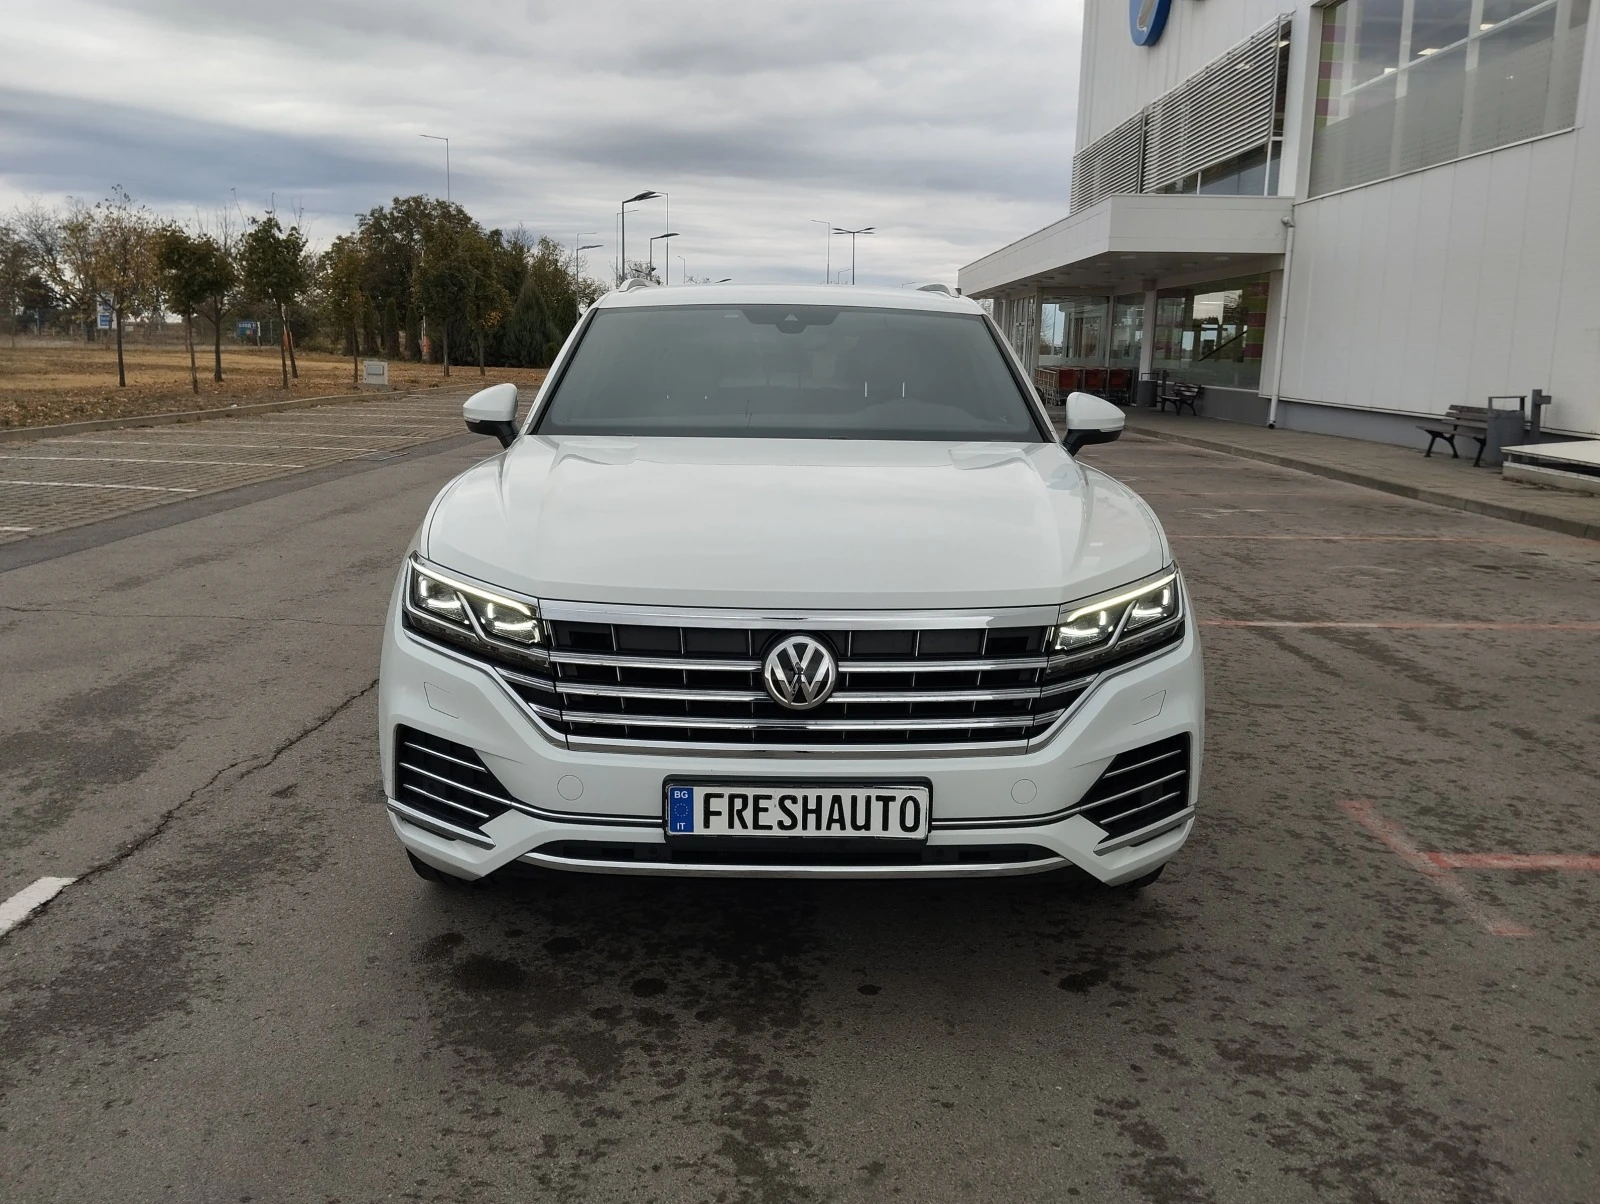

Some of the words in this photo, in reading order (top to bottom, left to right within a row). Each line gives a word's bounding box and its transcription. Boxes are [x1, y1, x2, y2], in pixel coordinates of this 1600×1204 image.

[765, 636, 835, 710] VW
[674, 790, 689, 799] BG
[703, 792, 921, 833] FRESHAUTO
[677, 822, 686, 830] IT
